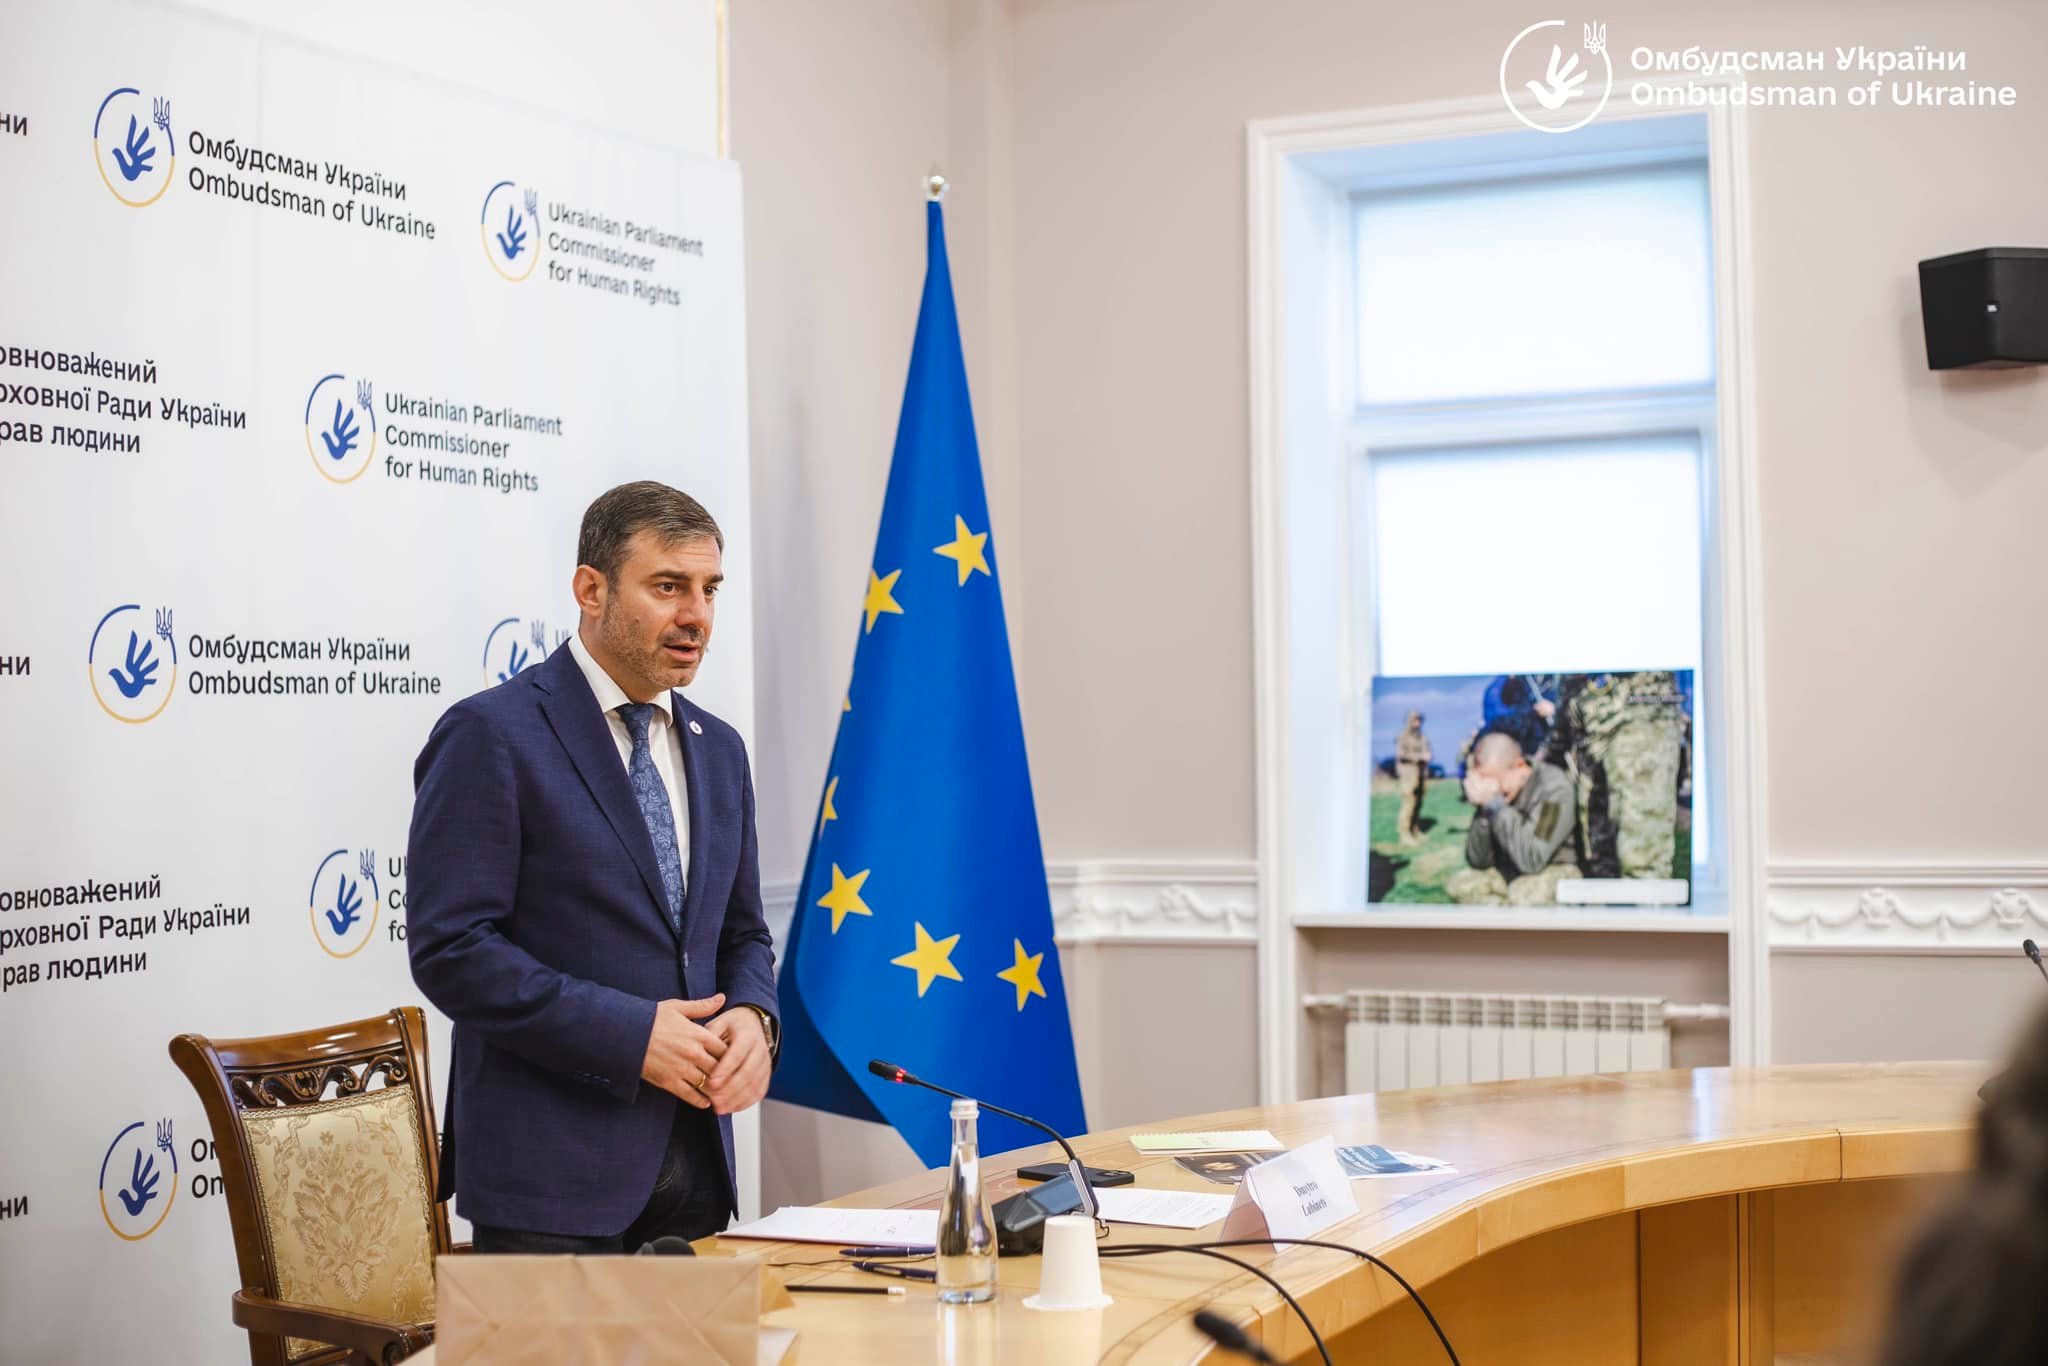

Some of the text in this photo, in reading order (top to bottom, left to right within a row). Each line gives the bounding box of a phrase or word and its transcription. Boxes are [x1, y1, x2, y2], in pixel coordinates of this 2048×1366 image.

[189, 131, 405, 200] Омбудсман України
[189, 167, 435, 239] Ombudsman of Ukraine
[549, 203, 703, 256] Ukrainian Parliament
[549, 233, 655, 271] Commissioner
[549, 260, 680, 306] for Human Rights
[98, 390, 151, 421] Ради
[161, 398, 245, 429] України
[386, 392, 562, 435] Ukrainian Parliament
[51, 426, 140, 453] людини
[386, 425, 509, 458] Commissioner
[385, 456, 538, 492] for Human Rights
[189, 634, 409, 665] Омбудсман України
[189, 670, 440, 694] Ombudsman of Ukraine
[99, 916, 156, 940] Ради
[163, 904, 249, 935] України
[388, 920, 408, 941] fo
[47, 952, 146, 980] людини
